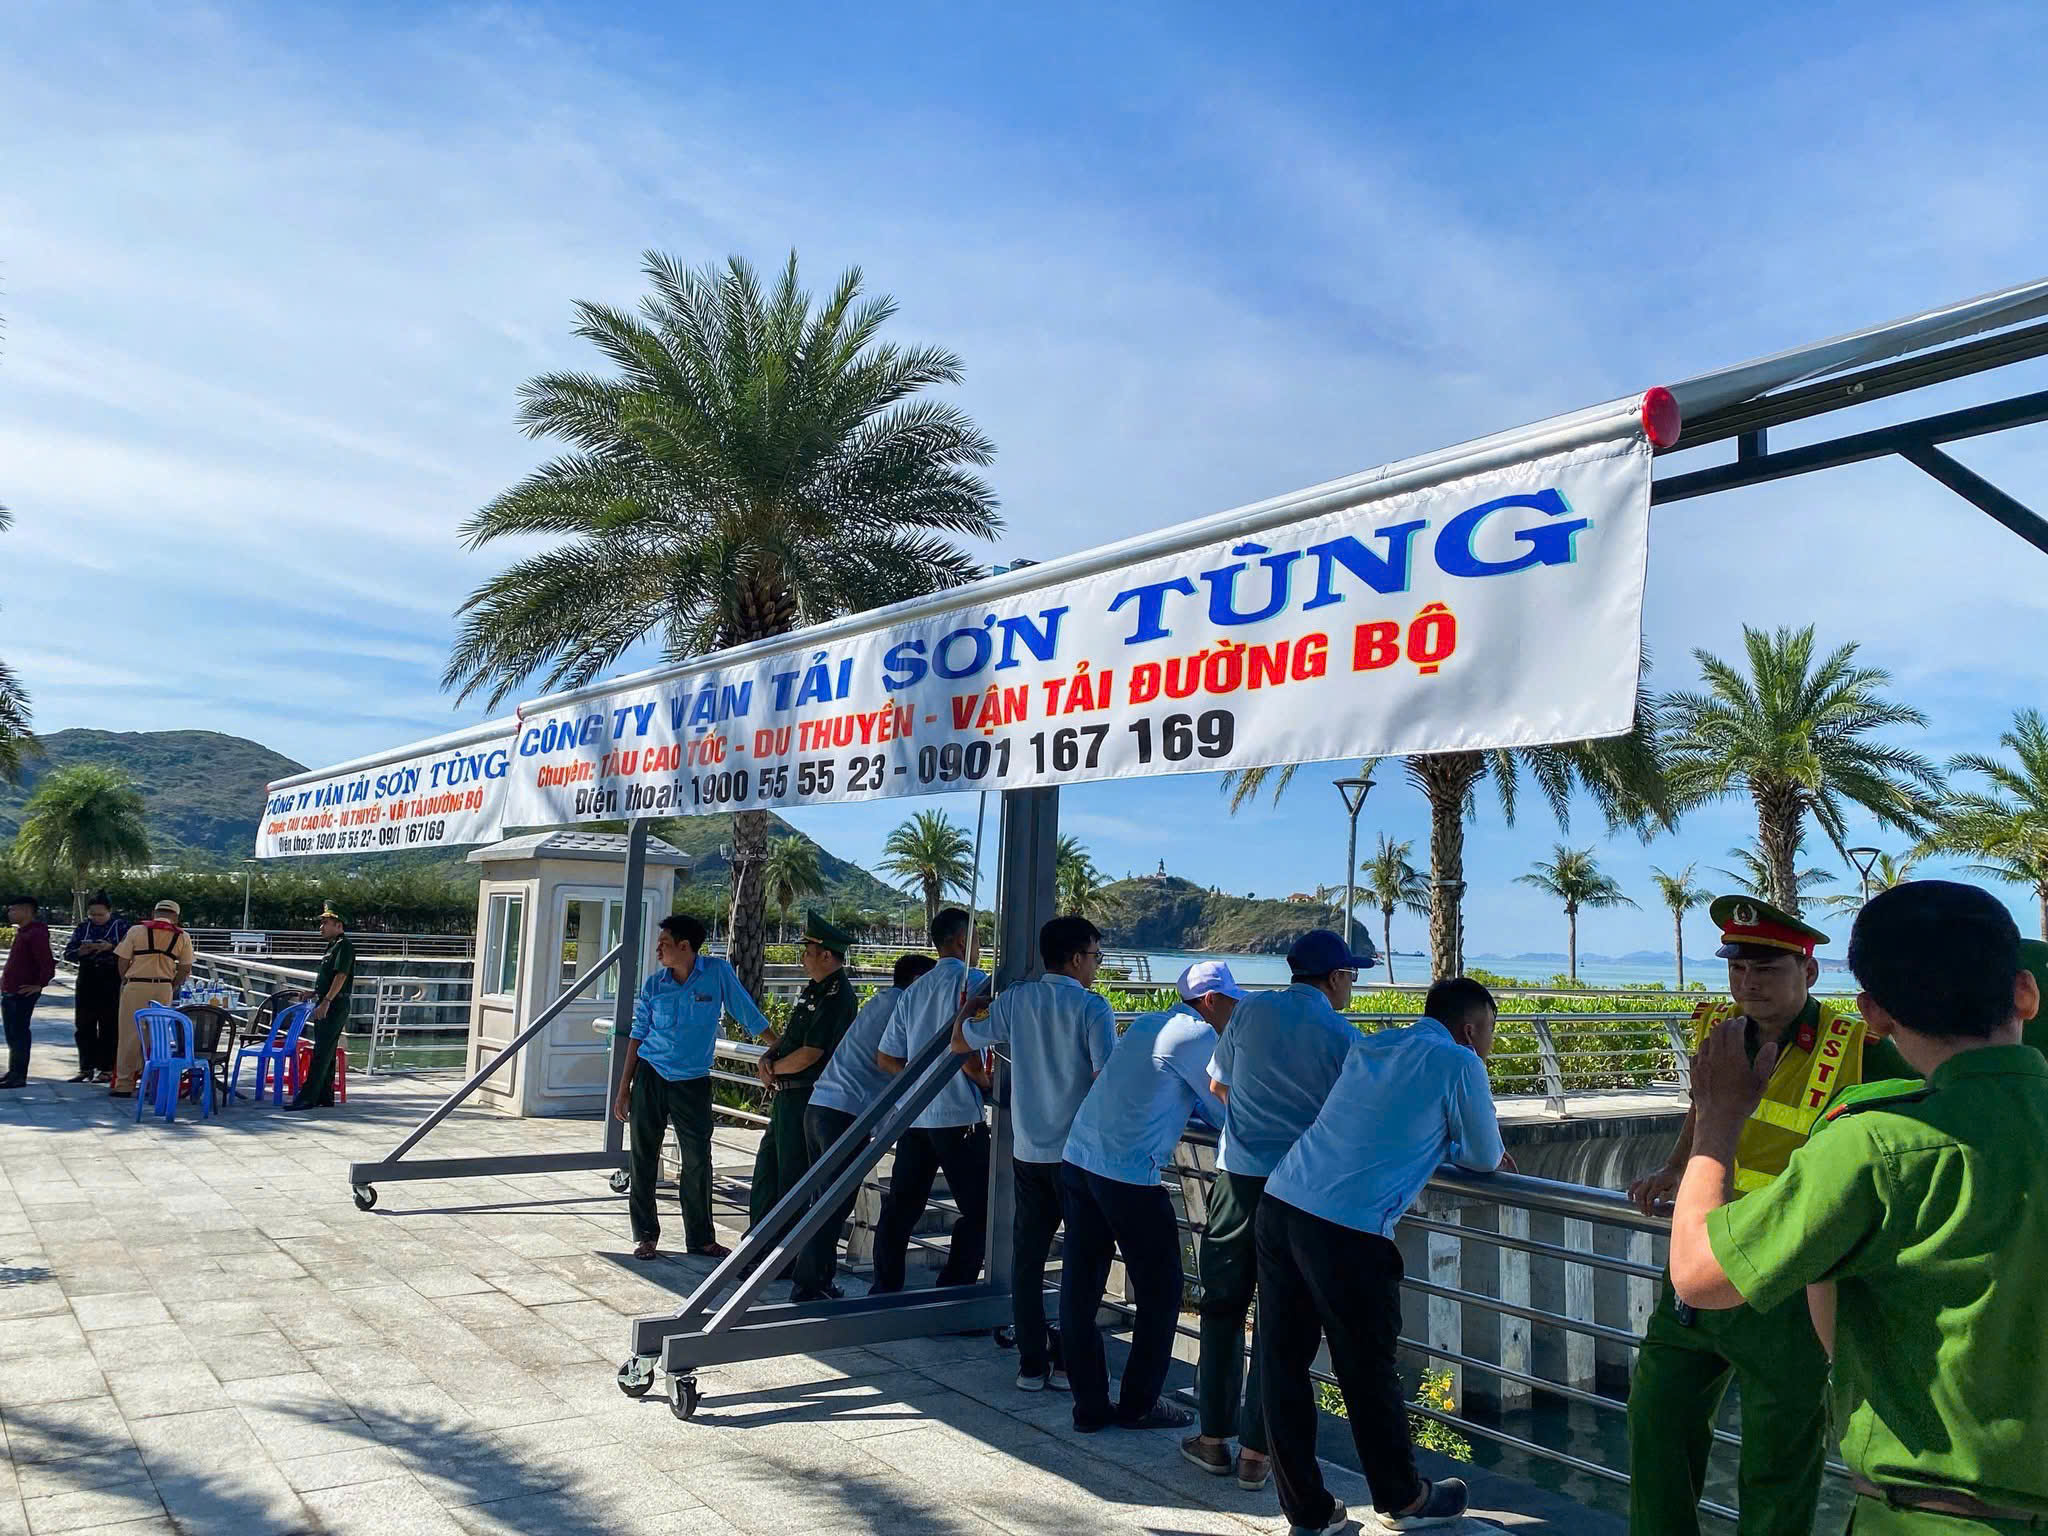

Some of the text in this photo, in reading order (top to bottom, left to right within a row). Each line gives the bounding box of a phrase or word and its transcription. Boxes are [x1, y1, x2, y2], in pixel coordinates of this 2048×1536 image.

[520, 488, 1594, 757] CÔNG TY VẬN TẢI SƠN TÙNG
[537, 757, 595, 789] Chuyên:
[600, 745, 639, 778] TÀU
[642, 743, 682, 773] CAO
[687, 727, 728, 766] TỐC
[754, 725, 792, 759] DU
[798, 698, 915, 752] THUYỀN
[952, 684, 1029, 736] VẬN
[1042, 660, 1113, 717] TẢI
[1129, 632, 1328, 705] ĐƯỜNG
[1352, 602, 1457, 675] BỘ
[267, 749, 510, 816] CÔNG TY VẬN TẢI SƠN TÙNG
[464, 785, 484, 813] BỘ
[575, 784, 622, 816] Điện
[625, 777, 683, 815] thoại:
[690, 769, 749, 805] 1900
[759, 765, 788, 800] 55
[797, 759, 834, 796] 55
[847, 753, 886, 792] 23
[918, 738, 1011, 784] 0901
[1030, 723, 1110, 774] 167
[1129, 709, 1235, 764] 169
[1808, 1018, 1851, 1109] CSTT
